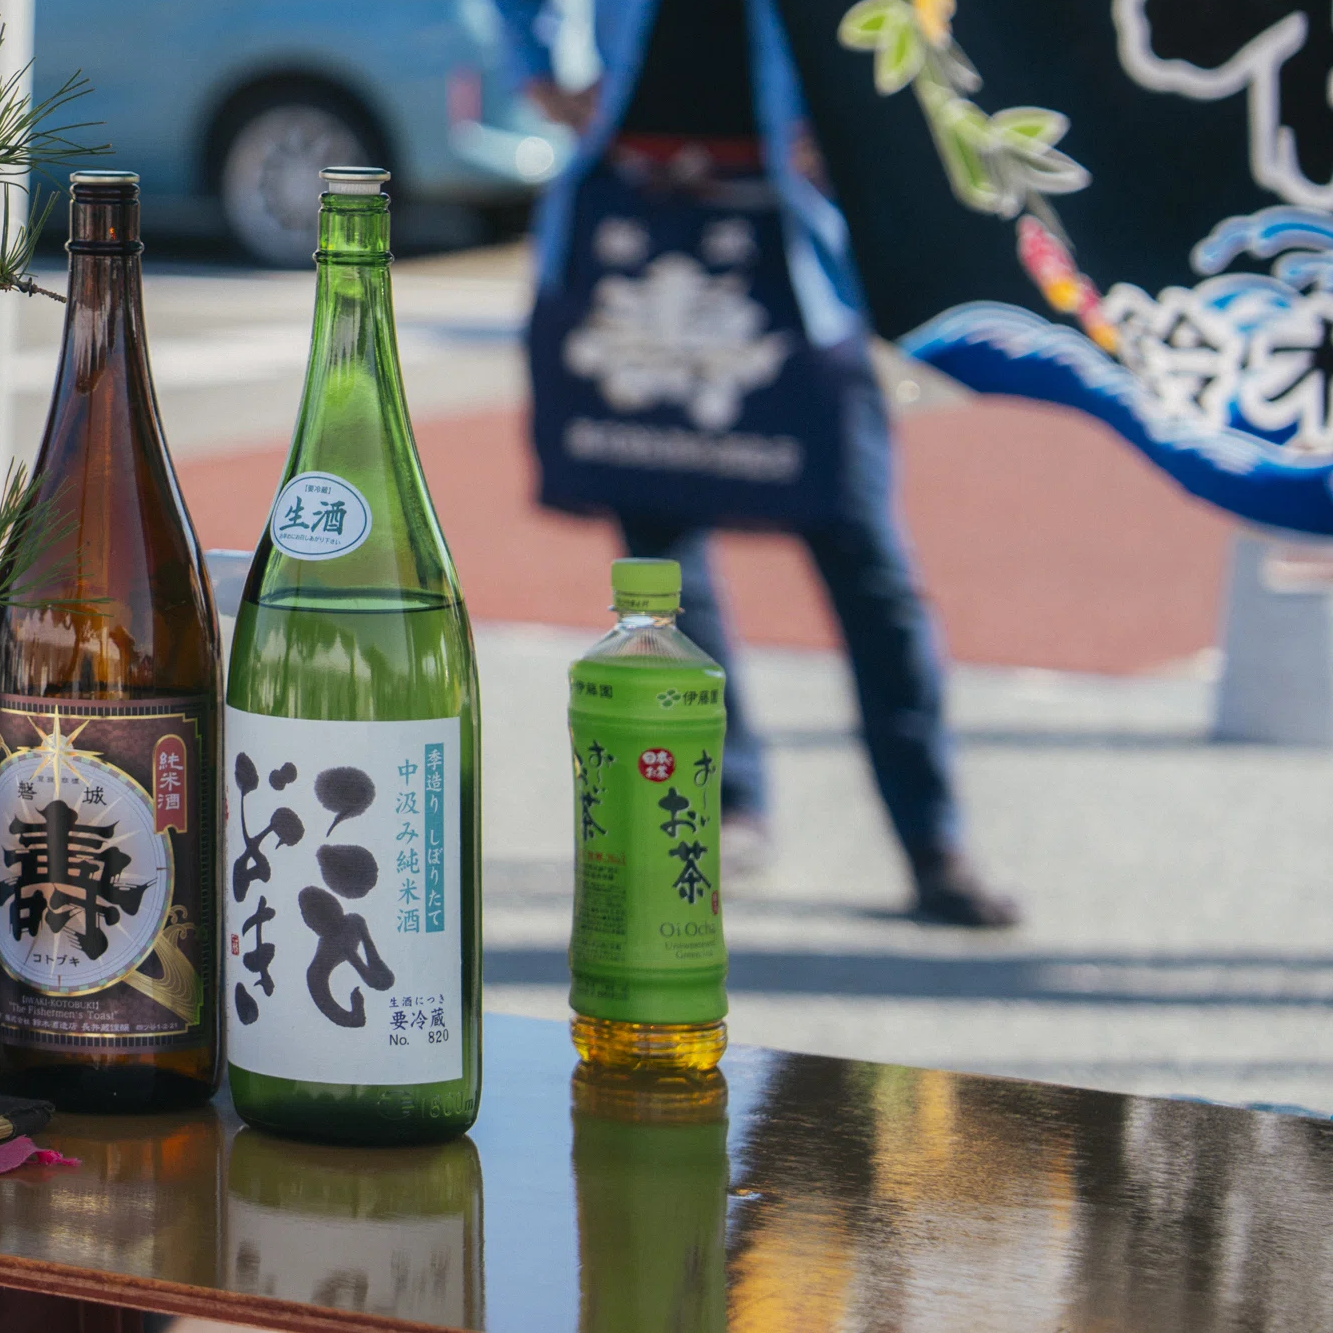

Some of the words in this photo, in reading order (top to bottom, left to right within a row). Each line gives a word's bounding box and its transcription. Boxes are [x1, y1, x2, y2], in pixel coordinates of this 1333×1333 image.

[279, 495, 347, 535] 生酒
[157, 752, 183, 811] 純米酒
[82, 786, 107, 806] 城
[396, 758, 421, 934] 中汲み純米酒
[658, 786, 712, 905] お茶
[427, 829, 443, 926] しぼりたて
[659, 921, 681, 937] Oi
[32, 953, 80, 967] コトブキ
[389, 994, 445, 1008] 生酒につき
[390, 1007, 446, 1031] 要冷蔵
[389, 1034, 410, 1046] No.
[428, 1029, 449, 1044] 820
